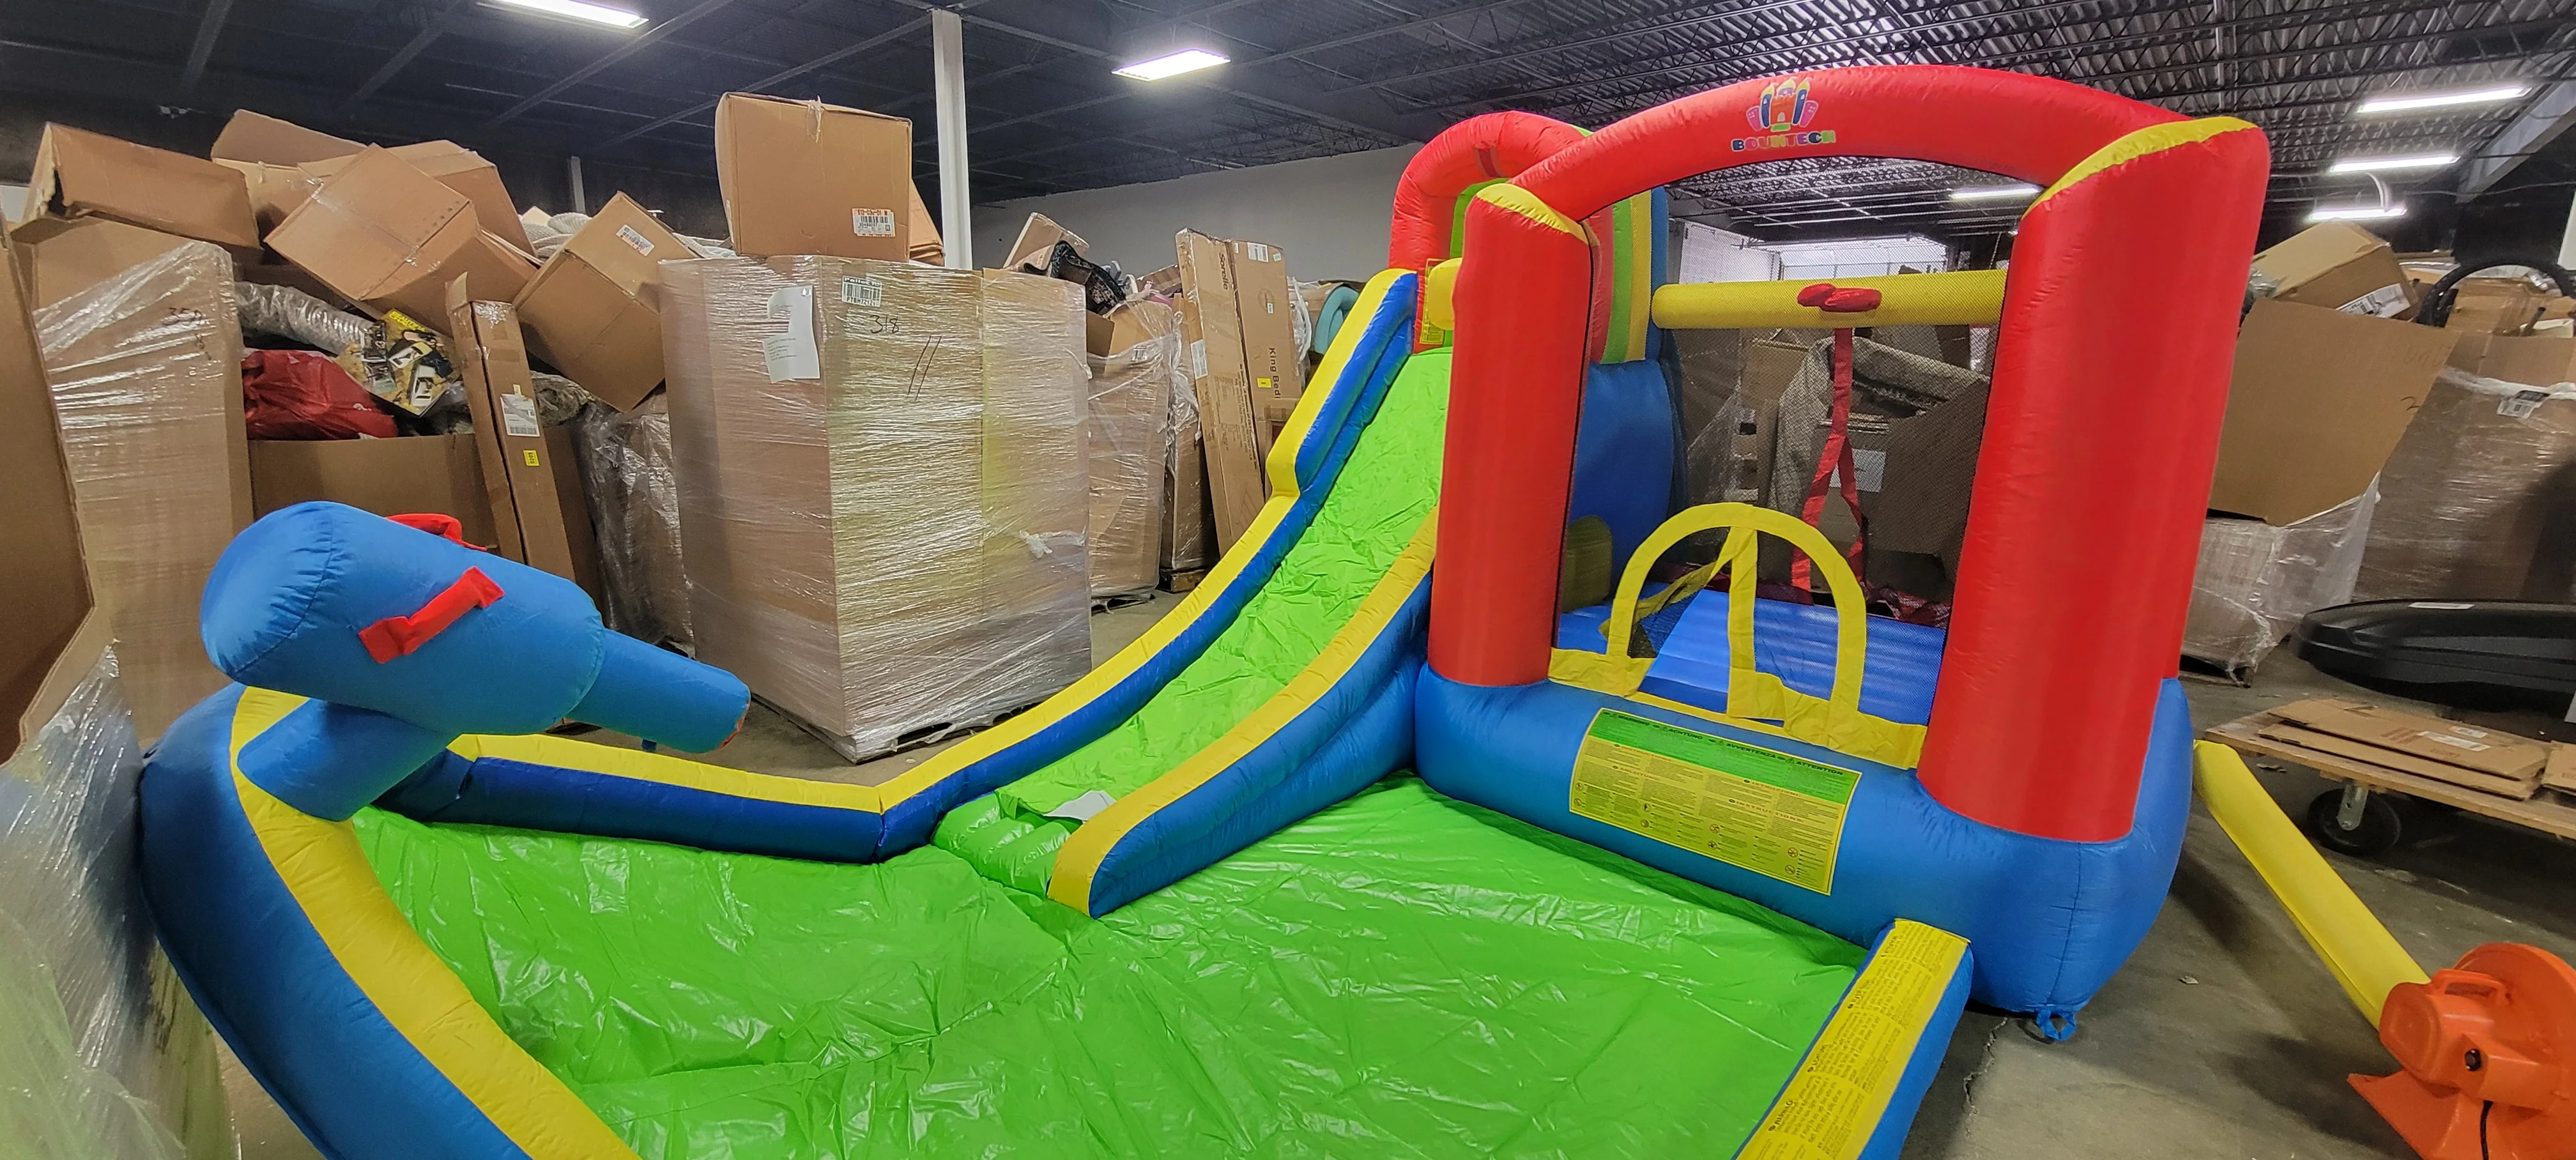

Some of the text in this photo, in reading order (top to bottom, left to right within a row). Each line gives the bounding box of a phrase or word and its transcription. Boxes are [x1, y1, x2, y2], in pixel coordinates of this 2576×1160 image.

[1731, 130, 1836, 151] BOUNTECH
[1219, 252, 1229, 290] Sorelle
[870, 315, 900, 333] 318
[1269, 347, 1277, 372] King
[1618, 715, 1650, 726] WARNING
[1667, 728, 1703, 740] ACHTUNG
[1726, 743, 1776, 759] AVVERTENZA
[1796, 761, 1843, 775] ATTENTION
